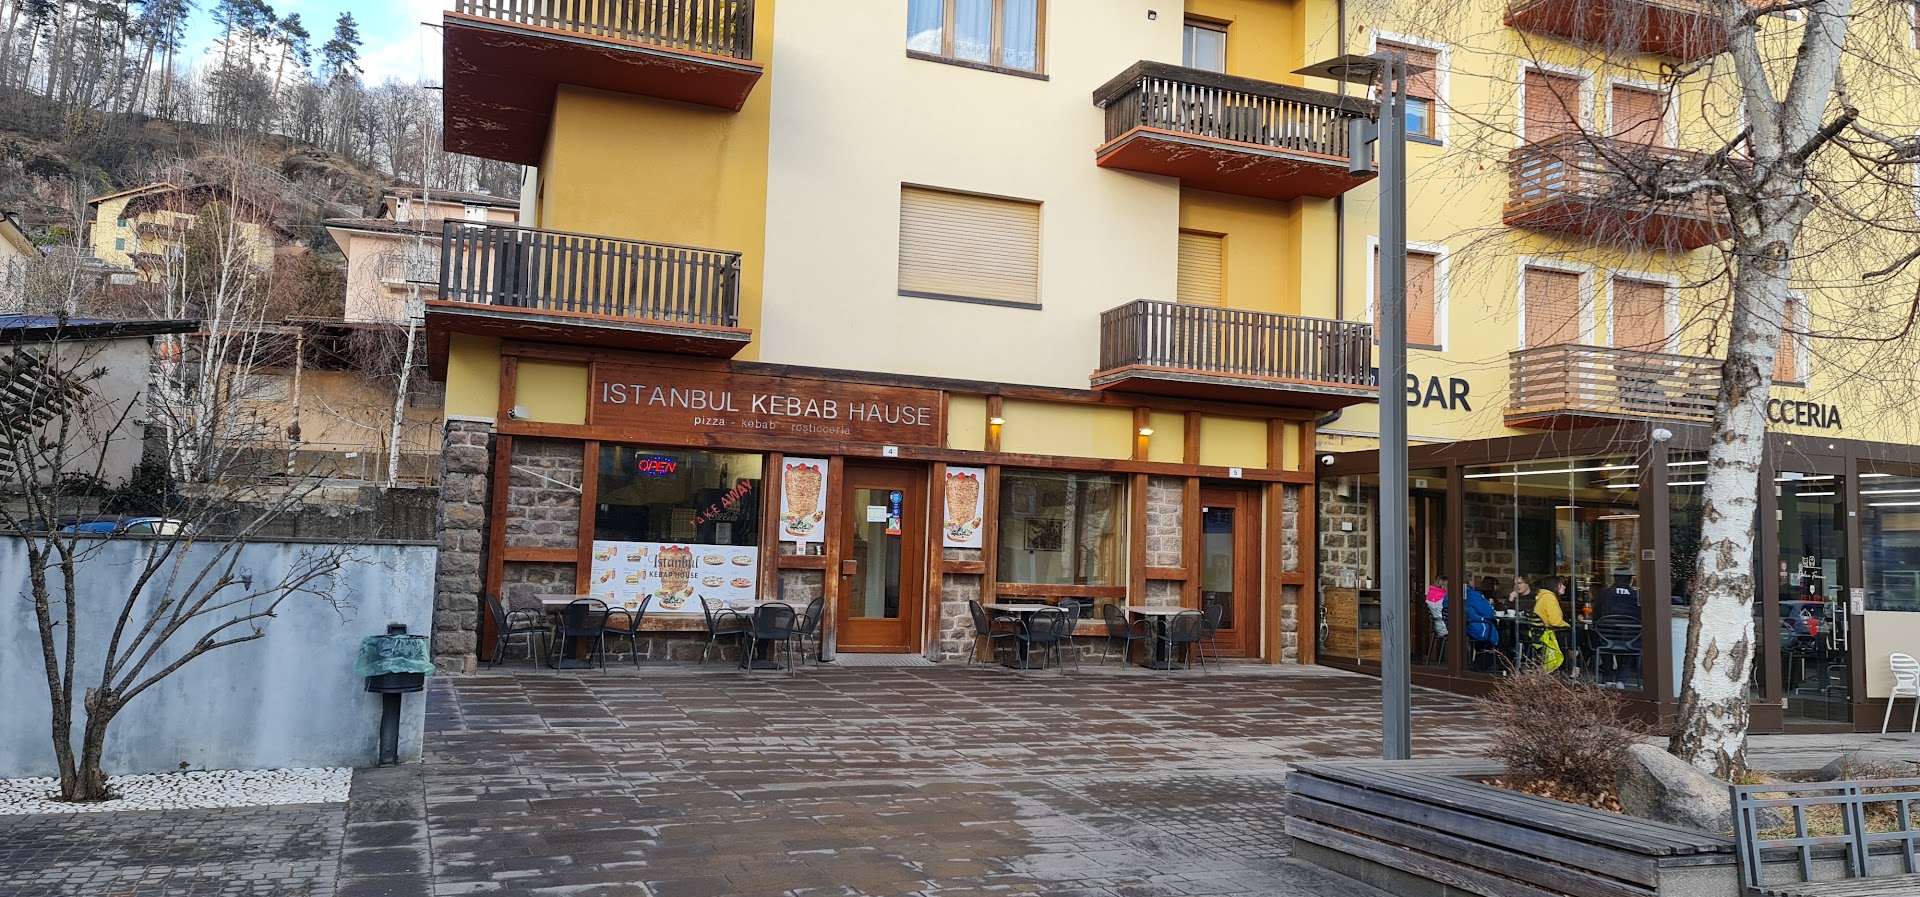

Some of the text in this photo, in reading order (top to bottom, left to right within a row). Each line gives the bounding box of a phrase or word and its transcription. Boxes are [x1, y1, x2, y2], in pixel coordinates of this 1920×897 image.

[1407, 374, 1471, 411] BAR
[602, 382, 931, 426] ISTANBUL KEBAB HAUSE
[1767, 399, 1842, 429] CCERIA
[694, 416, 725, 426] pizza
[741, 419, 776, 430] kebab
[791, 424, 850, 435] rosticceria
[638, 459, 677, 473] OPEN
[689, 479, 753, 527] TAKE AWAY
[648, 553, 700, 569] Istanbul
[674, 571, 699, 579] HOUSE
[1615, 587, 1631, 595] ITA
